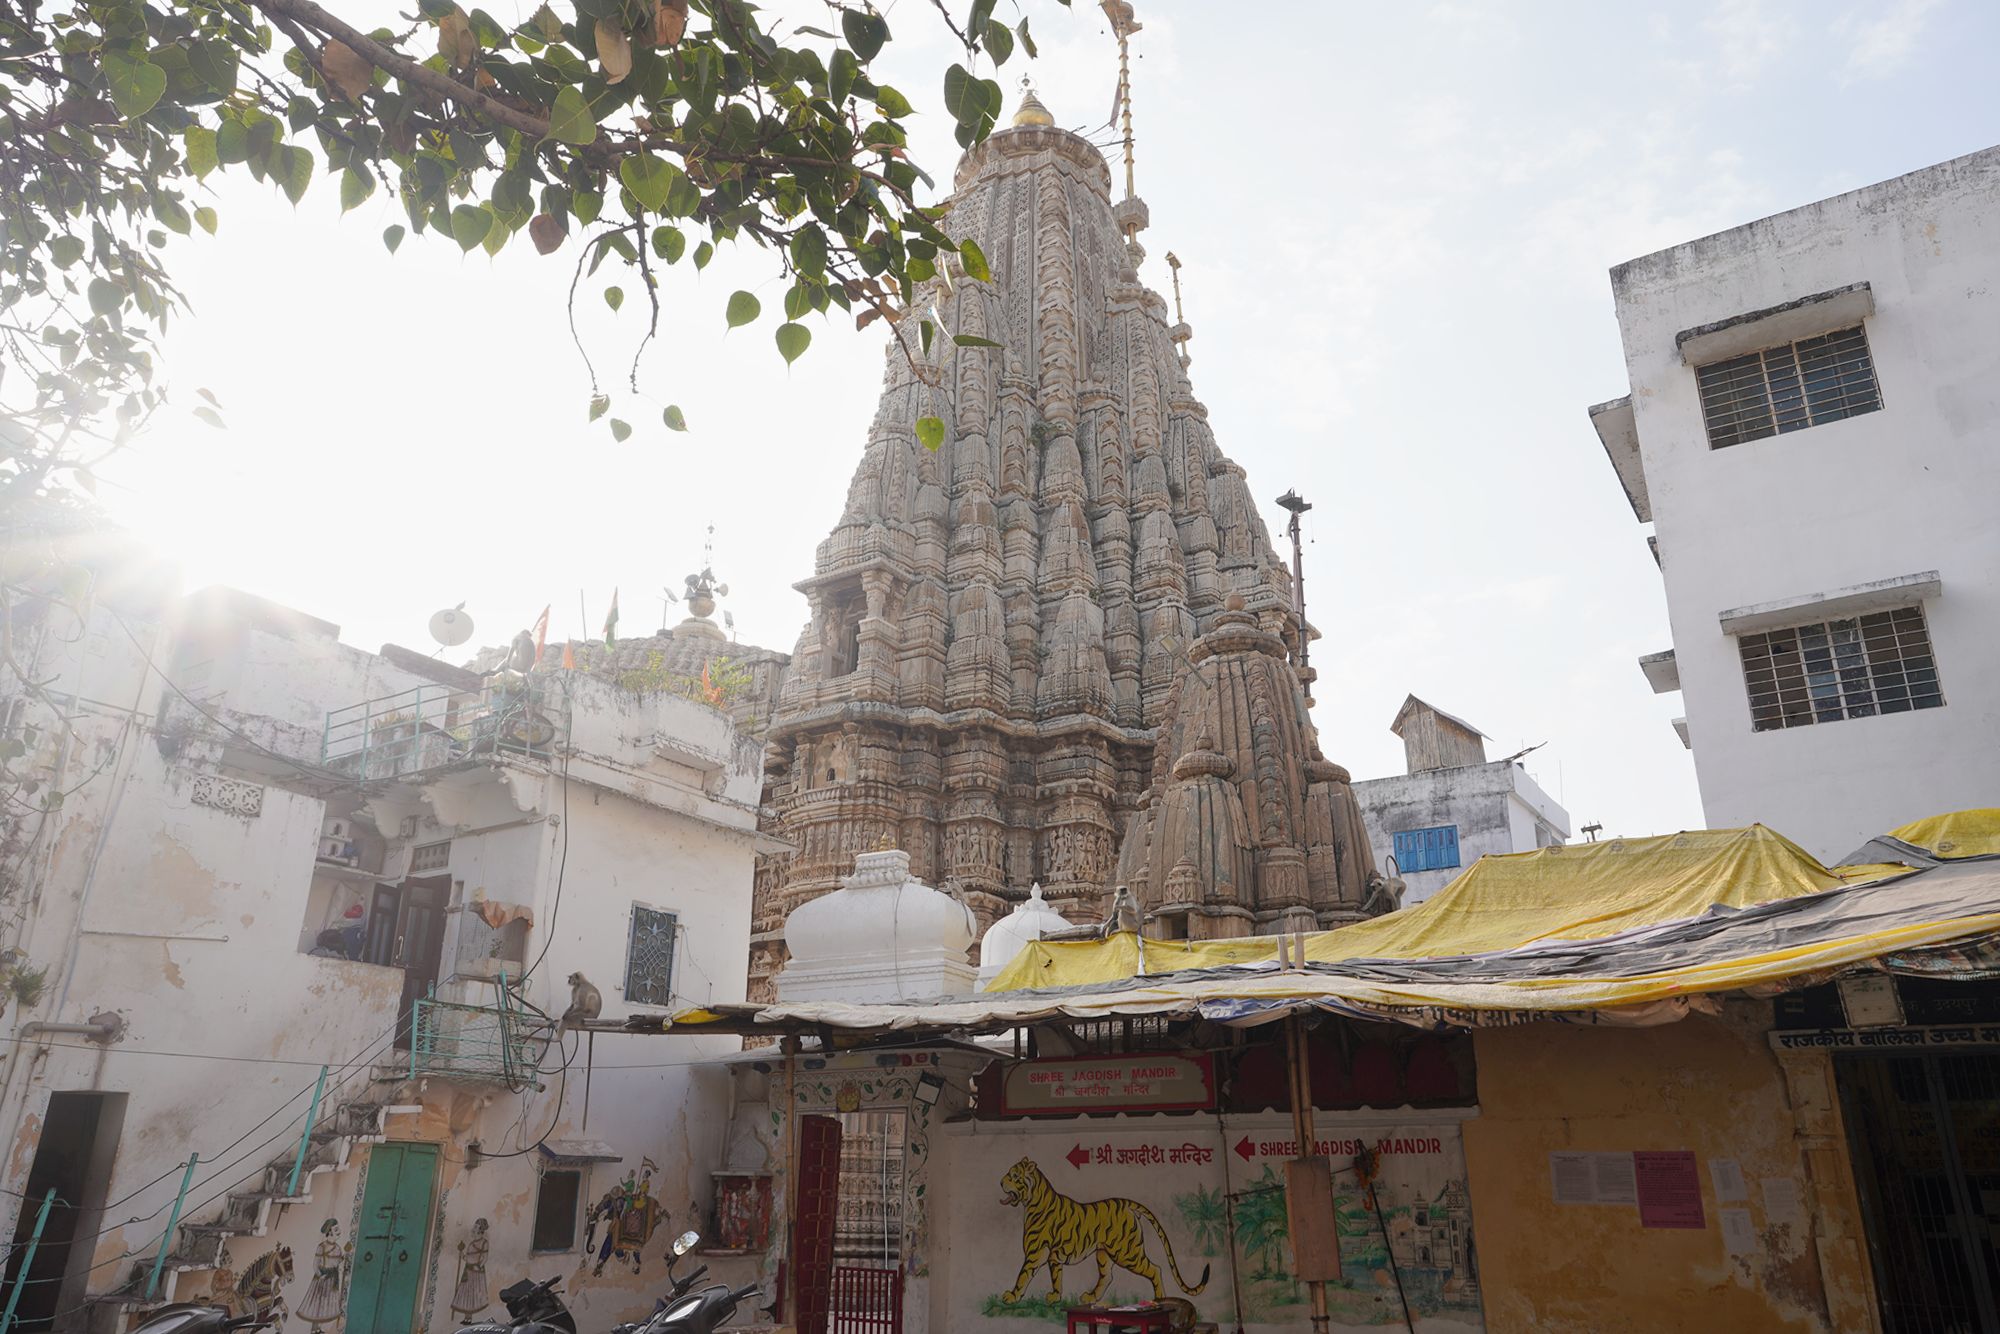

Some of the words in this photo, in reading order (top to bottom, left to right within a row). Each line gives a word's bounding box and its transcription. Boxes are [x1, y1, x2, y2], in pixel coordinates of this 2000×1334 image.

[1779, 1028, 1855, 1049] राजकीय
[1858, 1027, 1926, 1047] बालिका
[1930, 1028, 1977, 1044] उच्च
[1030, 1071, 1064, 1083] SHREE
[1072, 1069, 1121, 1082] JAGDISH
[1132, 1067, 1177, 1079] MANDIR
[1054, 1084, 1065, 1096] श्री
[1074, 1083, 1110, 1096] जगदीश
[1096, 1143, 1112, 1164] श्री
[1116, 1143, 1165, 1167] जगदीश
[1169, 1142, 1215, 1166] मन्दिर
[1260, 1142, 1297, 1156] SHREE
[1376, 1138, 1442, 1154] MANDIR
